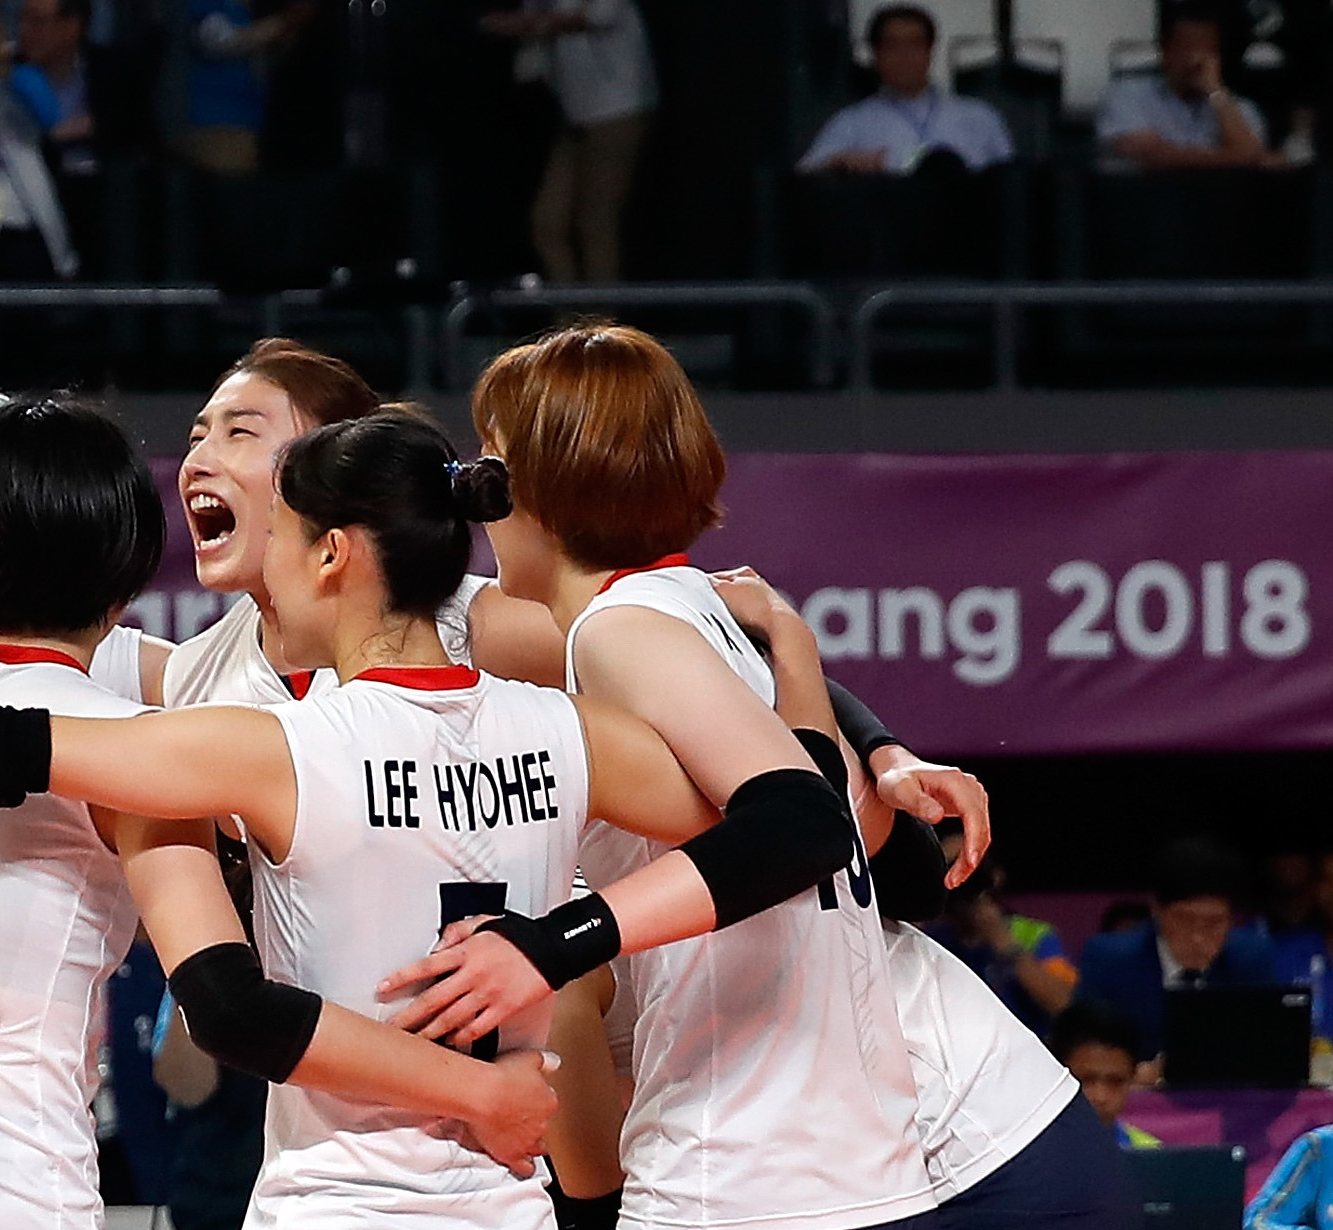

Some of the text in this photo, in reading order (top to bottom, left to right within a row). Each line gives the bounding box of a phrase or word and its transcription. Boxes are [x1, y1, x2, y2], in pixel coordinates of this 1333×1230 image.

[775, 587, 1024, 685] ang
[1047, 560, 1311, 659] 2018
[364, 749, 559, 832] LEE HYOHEE
